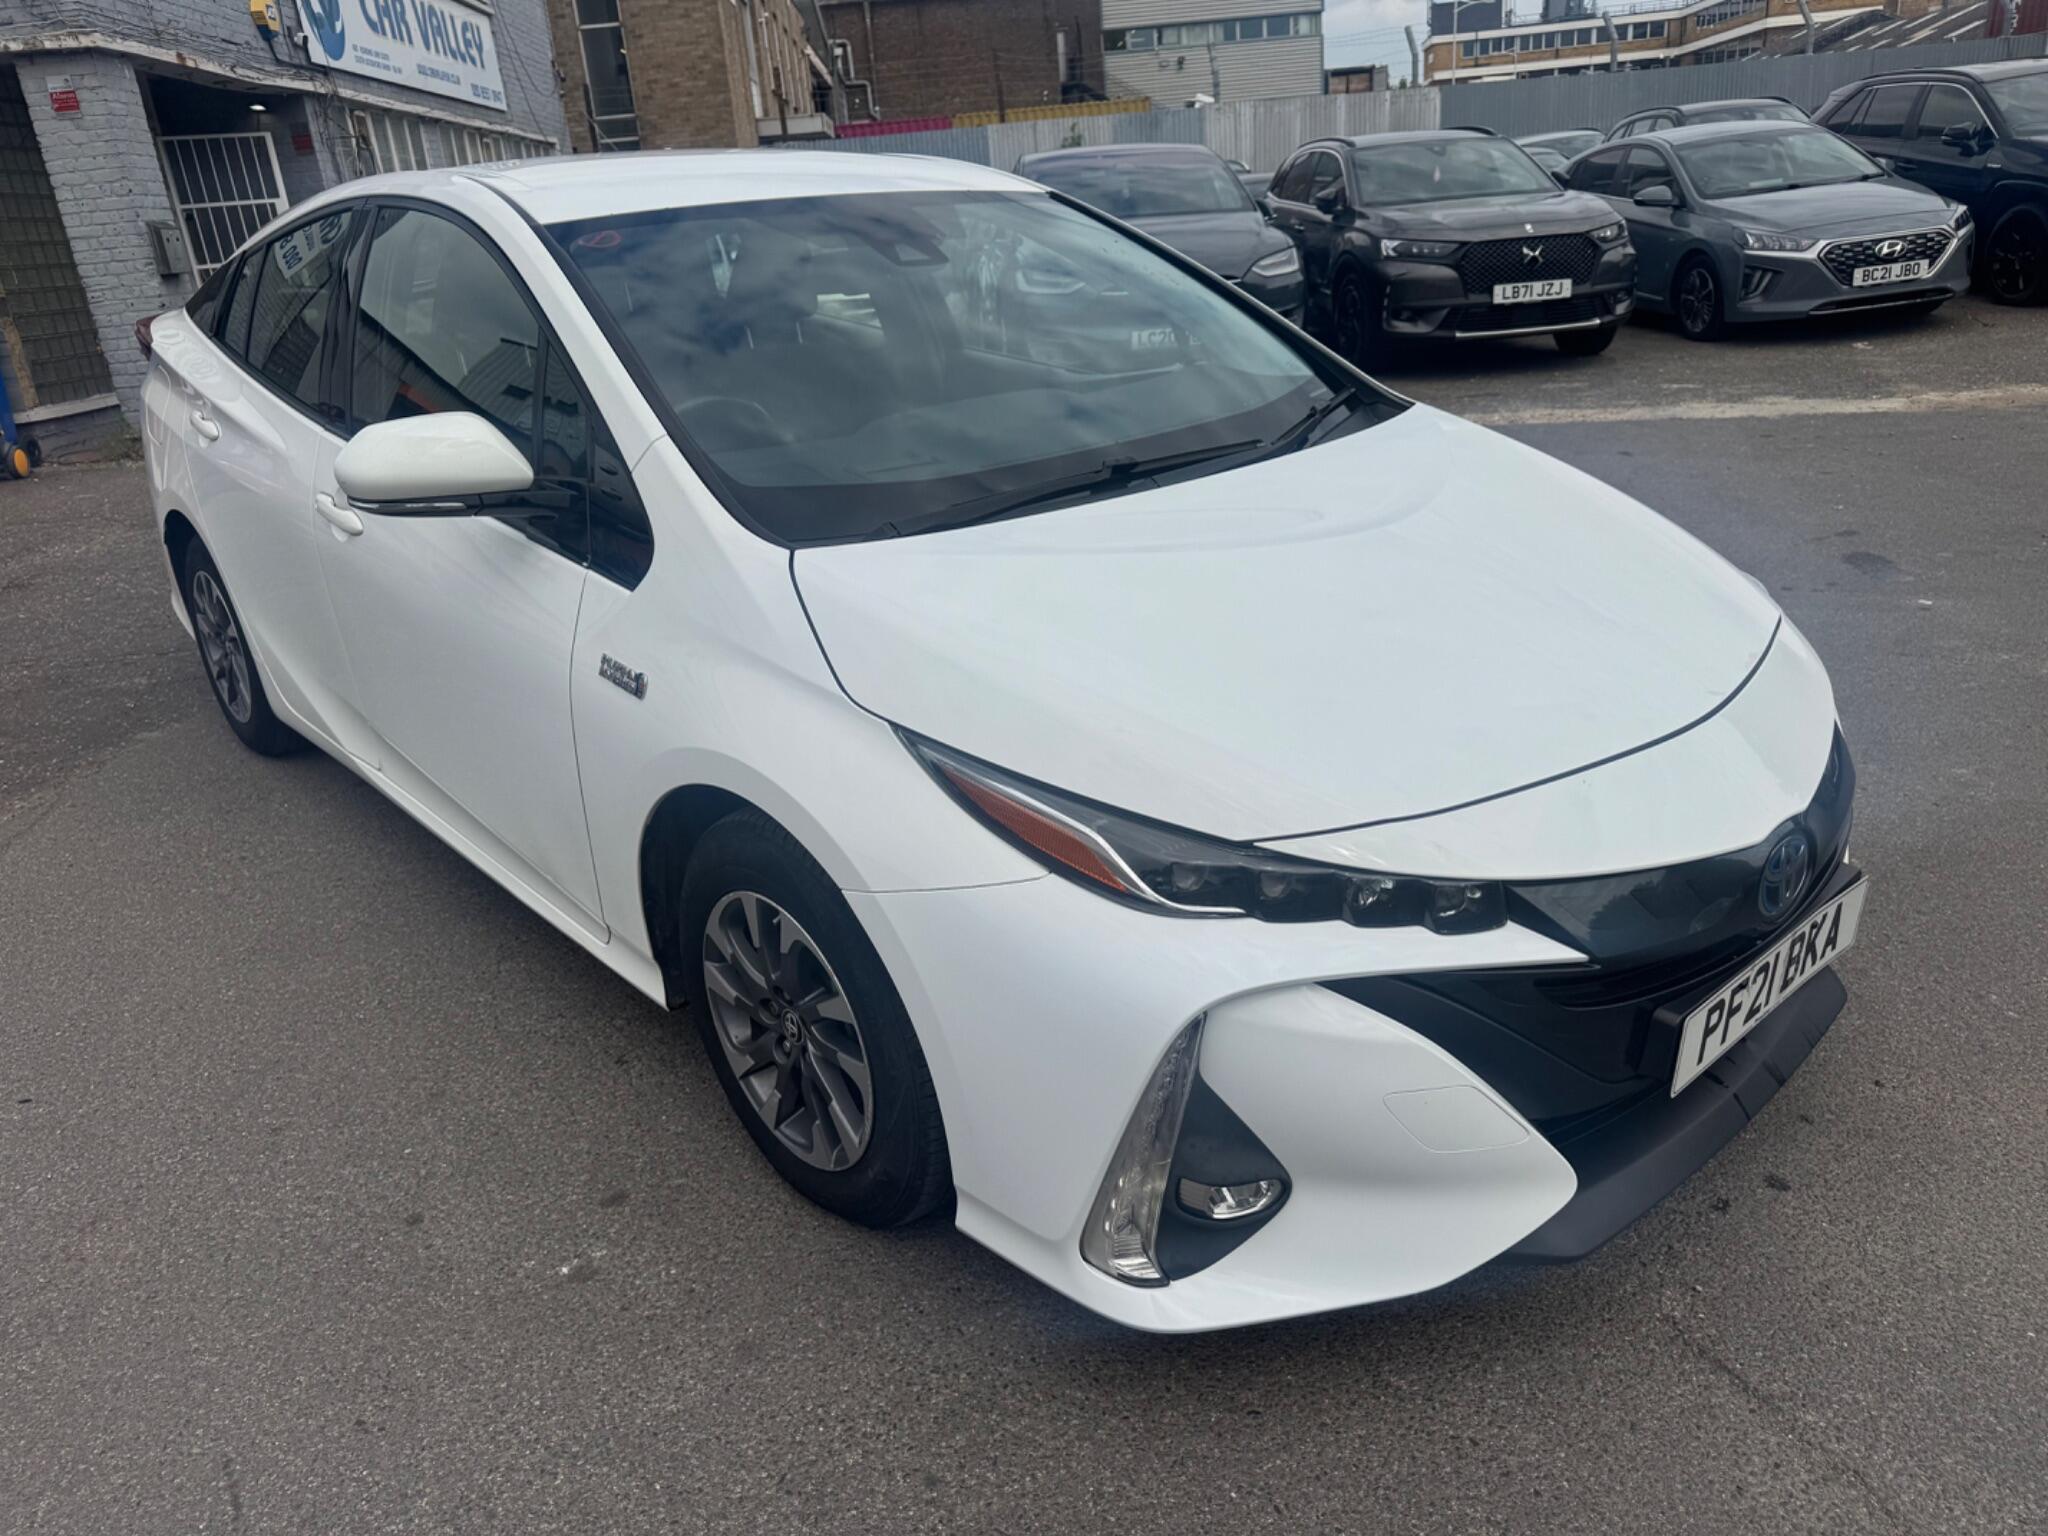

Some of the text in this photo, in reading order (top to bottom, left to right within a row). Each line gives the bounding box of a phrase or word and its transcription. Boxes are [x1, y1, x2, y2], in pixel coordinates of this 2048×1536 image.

[359, 0, 486, 70] CAR VALLEY
[1502, 281, 1563, 300] LB71 JZJ
[1861, 266, 1893, 282] BC21
[1697, 902, 1843, 1066] PF21 BKA
